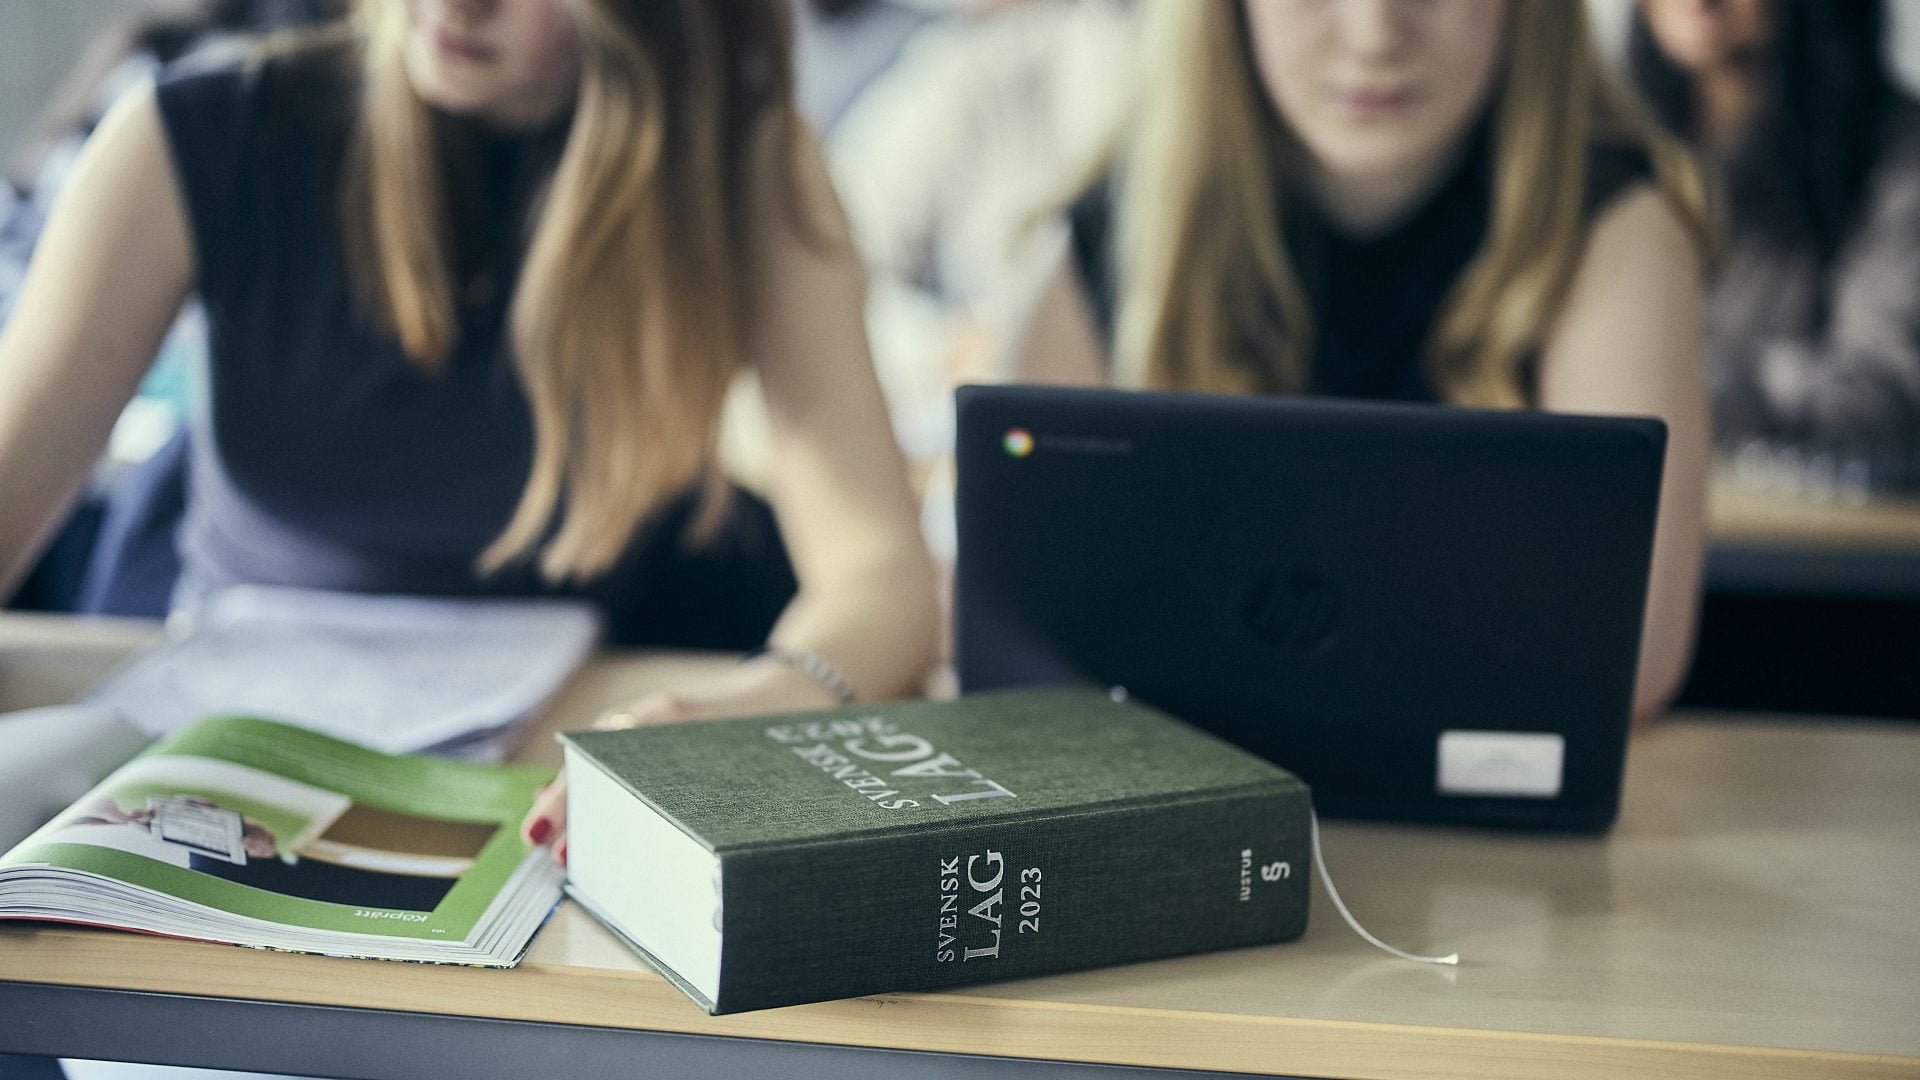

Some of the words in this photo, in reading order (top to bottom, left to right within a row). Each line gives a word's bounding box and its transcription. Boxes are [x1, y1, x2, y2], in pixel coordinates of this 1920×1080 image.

[791, 743, 921, 809] SVENSK
[843, 733, 1018, 805] LAG
[354, 909, 428, 922] Köprätt
[938, 855, 959, 962] SVENSK
[963, 848, 1004, 962] LAG
[1018, 867, 1041, 934] 2023
